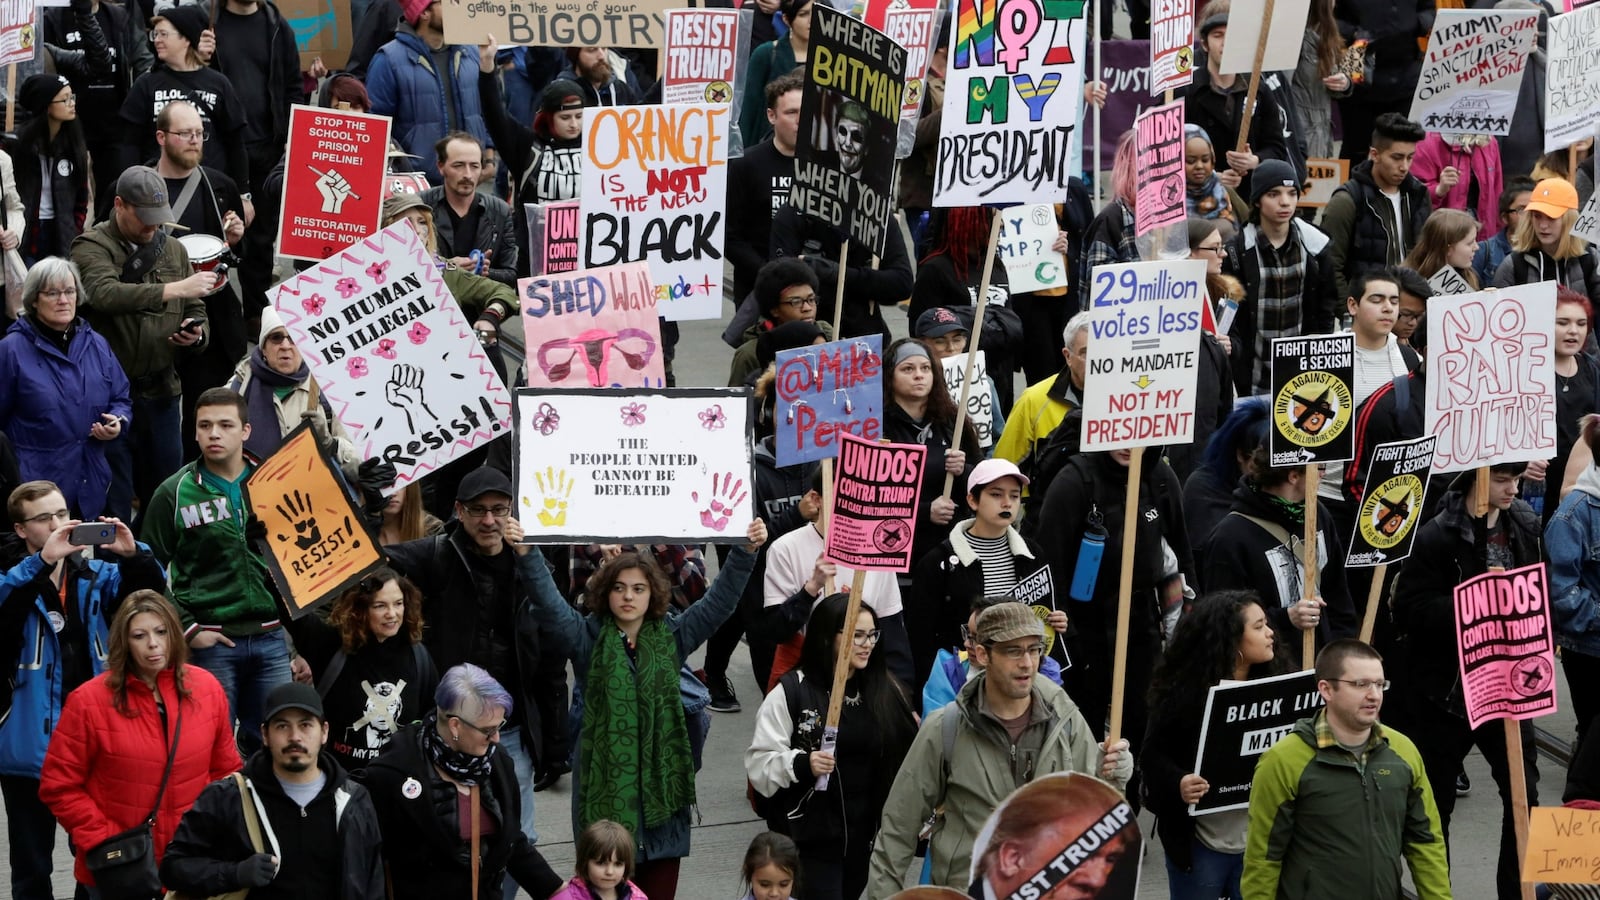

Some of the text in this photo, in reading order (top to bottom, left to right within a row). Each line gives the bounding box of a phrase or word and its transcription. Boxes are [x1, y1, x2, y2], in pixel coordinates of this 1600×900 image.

[467, 2, 637, 18] getting in the way of your
[671, 14, 735, 47] RESIST
[818, 10, 883, 60] WHERE
[888, 43, 902, 75] IS
[953, 0, 1085, 74] NOT
[1154, 15, 1191, 55] TRUMP
[1430, 16, 1537, 62] LEAVE OUR
[1435, 15, 1502, 45] TRUMP
[1549, 14, 1578, 48] YOU
[1567, 31, 1596, 57] HAVE
[669, 47, 732, 80] TRUMP
[1419, 47, 1518, 100] OUR HOMES
[1478, 52, 1527, 87] ALONE
[813, 45, 901, 125] BATMAN
[966, 73, 1062, 124] MY
[309, 128, 370, 143] SCHOOL TO
[314, 116, 366, 131] STOP THE
[588, 108, 728, 171] ORANGE
[312, 152, 363, 166] PIPELINE!
[318, 140, 358, 153] PRISON
[934, 125, 1075, 198] PRESIDENT
[601, 174, 625, 195] IS
[647, 166, 707, 196] NOT
[794, 158, 850, 203] WHEN
[857, 181, 886, 229] YOU
[610, 188, 707, 212] THE NEW
[294, 216, 367, 234] RESTORATIVE
[790, 184, 843, 226] NEED
[850, 208, 879, 252] HIM
[291, 229, 336, 241] JUSTICE
[585, 211, 722, 269] BLACK
[526, 275, 606, 318] SHED
[1094, 269, 1198, 308] 2.9 million
[308, 272, 422, 343] NO HUMAN
[1092, 305, 1199, 339] votes less
[321, 295, 435, 364] IS ILLEGAL
[1443, 298, 1526, 352] NO
[1090, 351, 1194, 375] NO MANDATE
[1276, 338, 1352, 358] FIGHT RACISM
[1300, 353, 1352, 370] & SEXISM
[1436, 333, 1547, 410] RAPE
[1109, 388, 1184, 414] NOT MY
[1276, 373, 1350, 414] UNITE AGAINST TRUMP
[383, 396, 500, 466] Resist!
[618, 438, 648, 449] THE
[1087, 412, 1193, 444] PRESIDENT
[1284, 426, 1295, 437] THE
[1293, 433, 1328, 444] BILLIONAIRE
[1329, 420, 1345, 437] CLASS
[1432, 394, 1555, 469] CULTURE
[569, 453, 698, 466] PEOPLE UNITED
[844, 441, 920, 483] UNIDOS
[1375, 438, 1435, 462] FIGHT RACISM
[1393, 453, 1433, 475] & SEXISM
[591, 469, 676, 481] CANNOT BE
[594, 484, 670, 496] DEFEATED
[840, 477, 914, 504] CONTRA TRUMP
[1383, 476, 1415, 493] AGAINST
[180, 498, 231, 529] MEX
[841, 500, 848, 509] LA
[848, 502, 862, 514] CLASE
[291, 515, 360, 576] RESIST!
[1015, 570, 1048, 600] RACISM
[1460, 571, 1541, 625] UNIDOS
[1463, 615, 1545, 649] CONTRA TRUMP
[1465, 654, 1469, 665] Y
[1469, 651, 1476, 662] LA
[1476, 645, 1493, 660] CLASE
[1226, 698, 1283, 723] BLACK
[353, 748, 368, 759] MY
[1049, 803, 1131, 874] TRUMP
